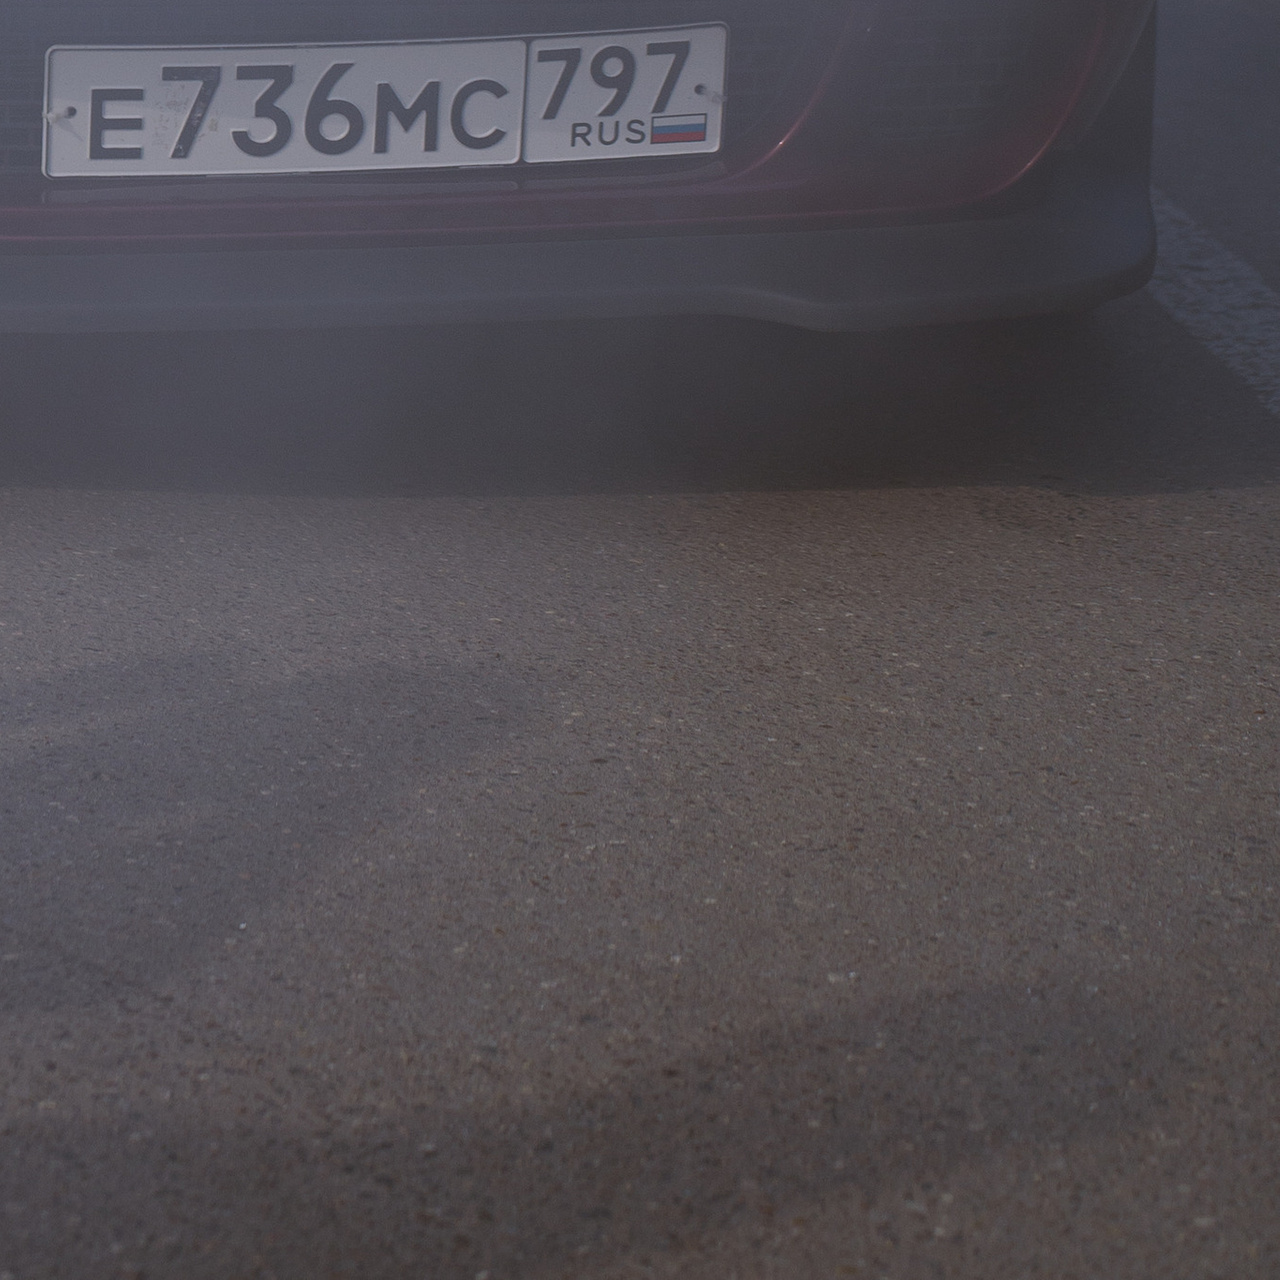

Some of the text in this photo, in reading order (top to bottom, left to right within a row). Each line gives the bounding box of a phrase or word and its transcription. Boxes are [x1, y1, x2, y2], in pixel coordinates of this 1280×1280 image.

[88, 40, 691, 160] E736MC 797
[570, 118, 647, 148] RUS
